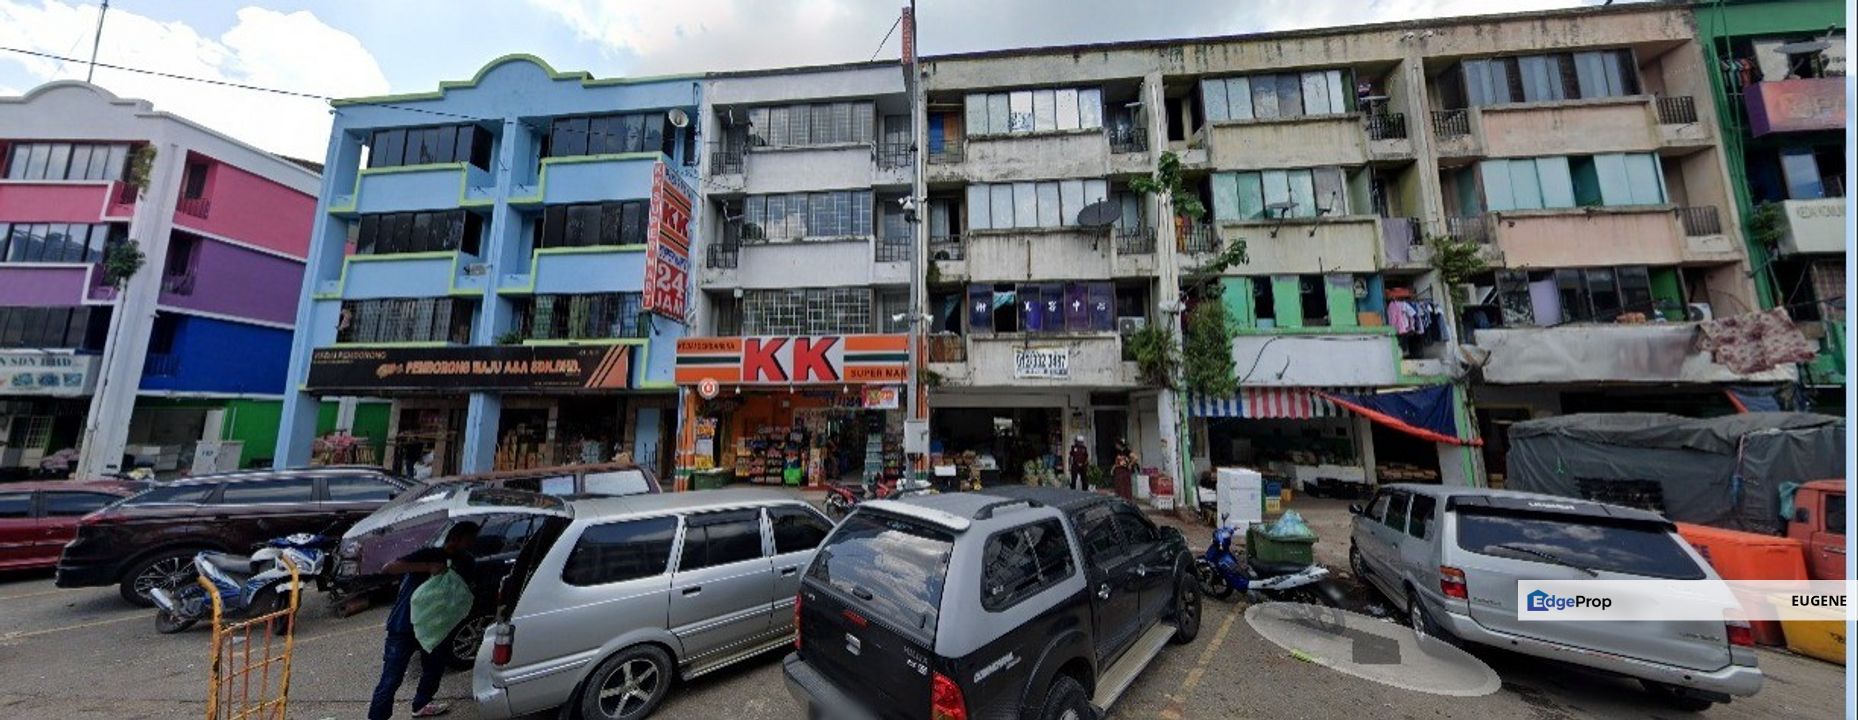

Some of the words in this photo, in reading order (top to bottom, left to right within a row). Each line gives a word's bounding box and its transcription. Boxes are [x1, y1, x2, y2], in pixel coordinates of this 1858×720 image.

[662, 201, 689, 239] KK
[656, 262, 685, 299] 24
[655, 290, 684, 318] JAM
[743, 337, 839, 381] KK
[850, 368, 882, 378] SUPER
[885, 367, 908, 377] MAR
